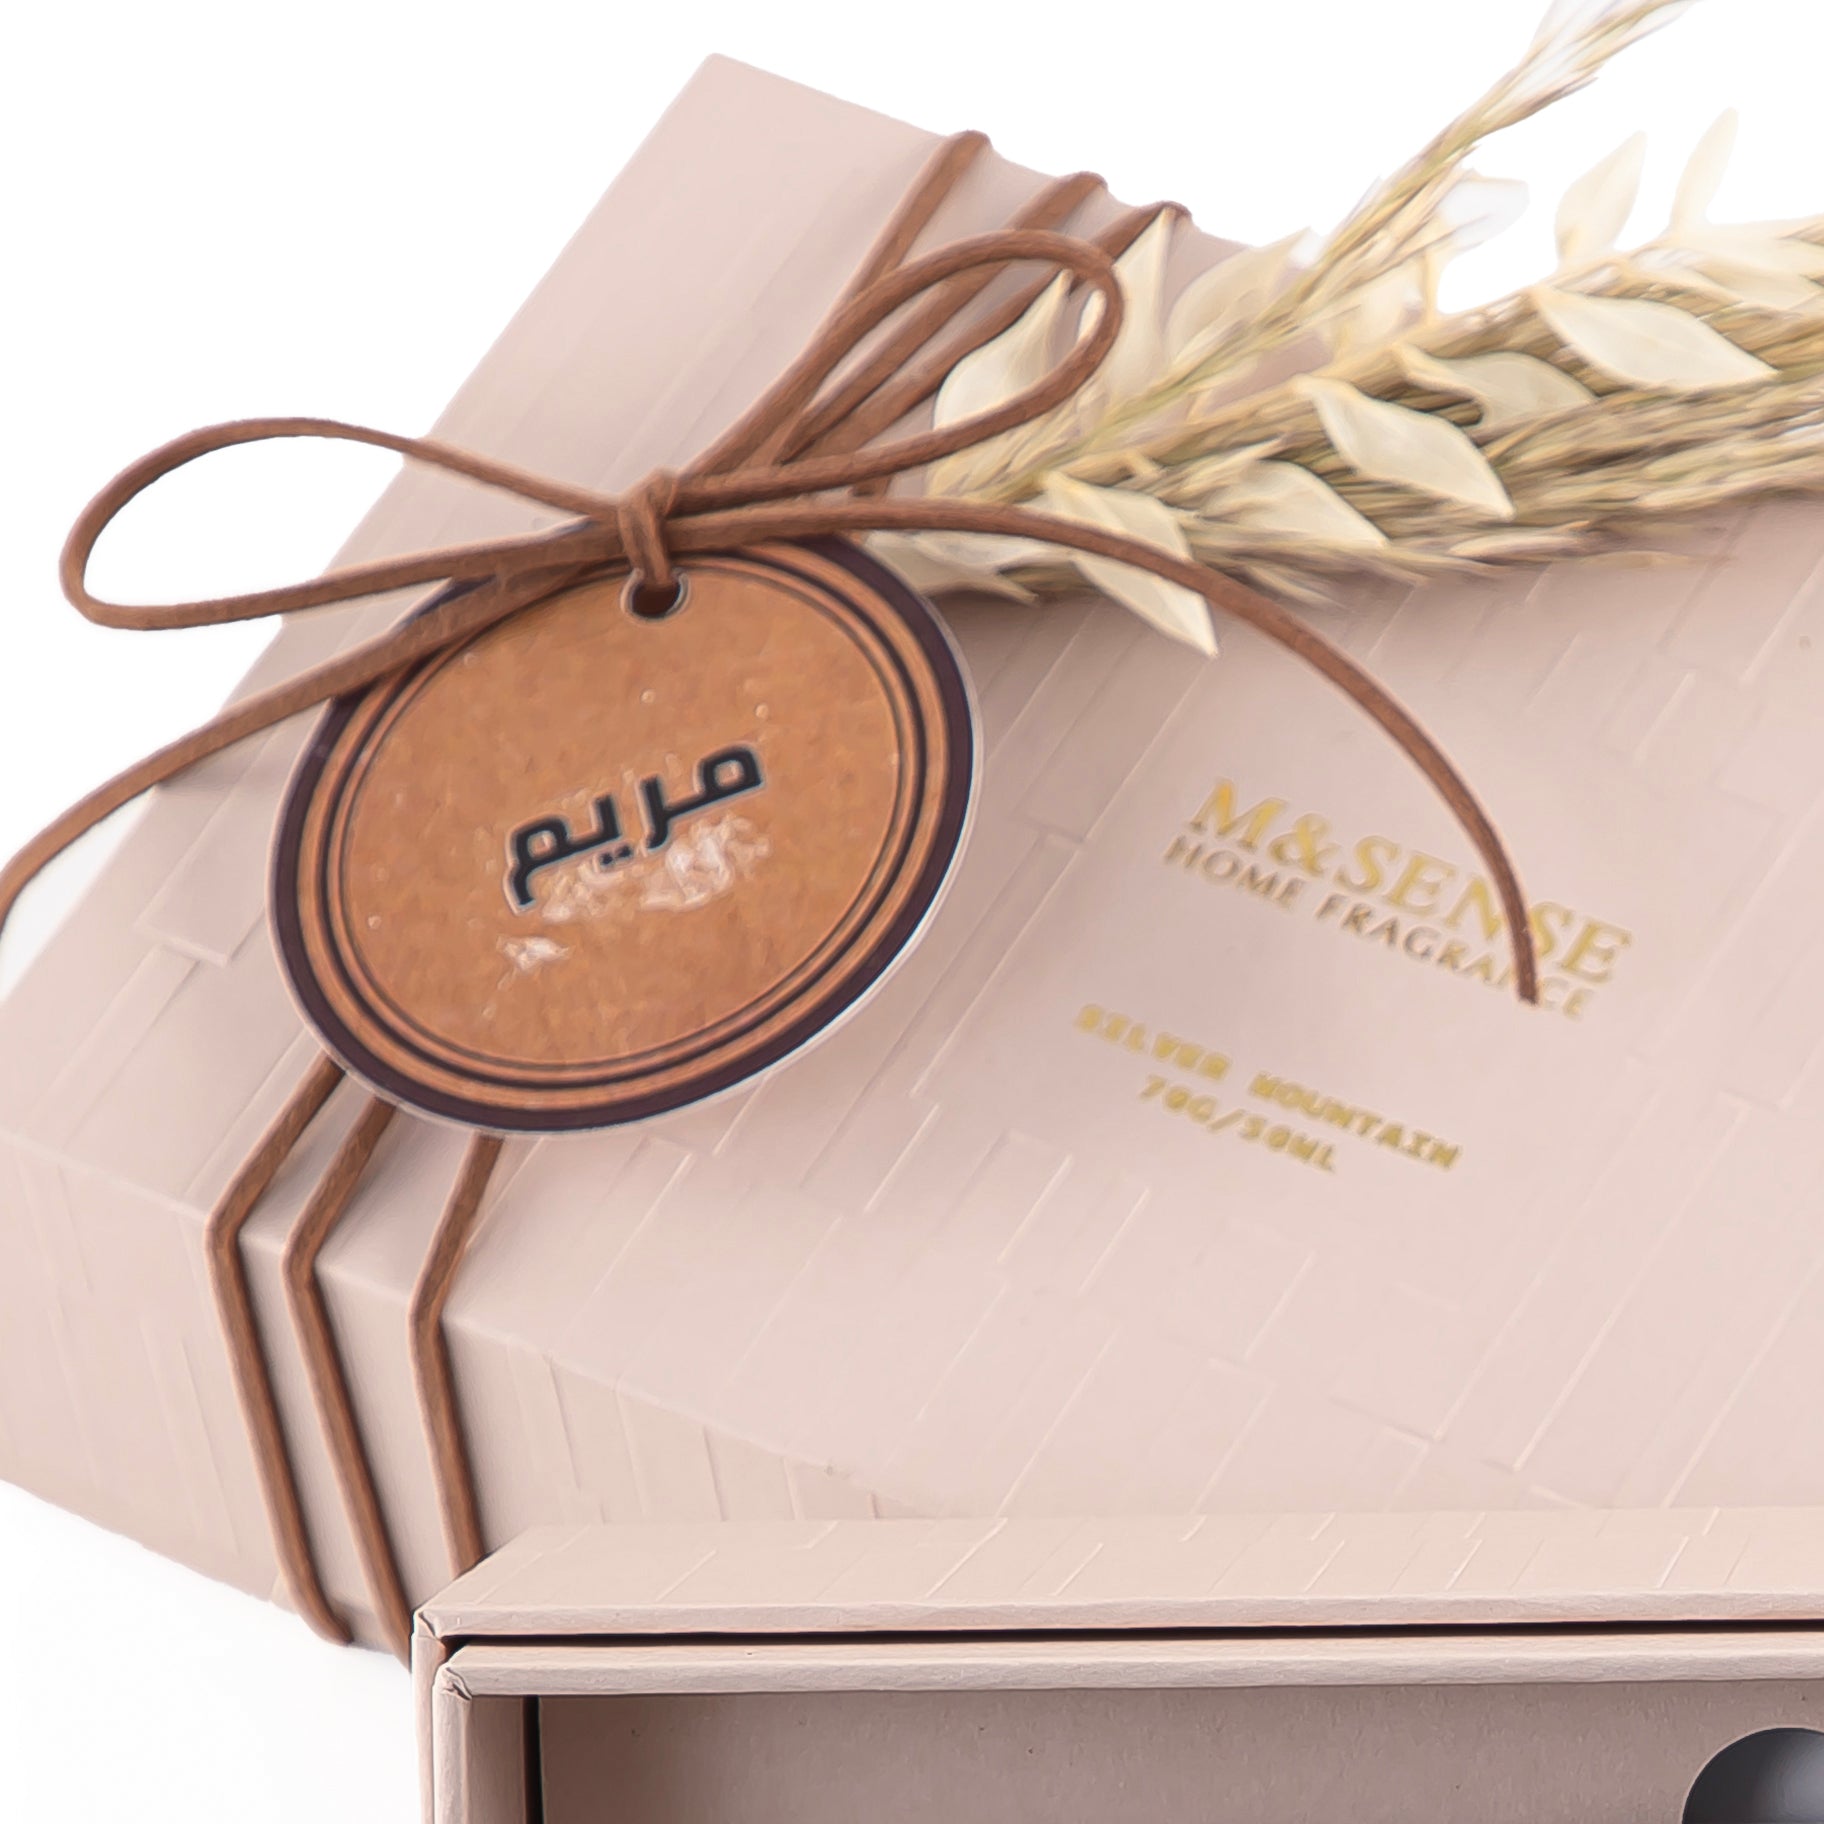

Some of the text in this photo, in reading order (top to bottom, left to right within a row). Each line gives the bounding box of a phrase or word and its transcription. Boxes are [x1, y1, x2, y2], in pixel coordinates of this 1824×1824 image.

[511, 746, 763, 907] مريم
[1162, 834, 1305, 908] HOME
[1186, 778, 1634, 985] M&SENSE
[1075, 1003, 1463, 1171] SILVER MOUNTAIN
